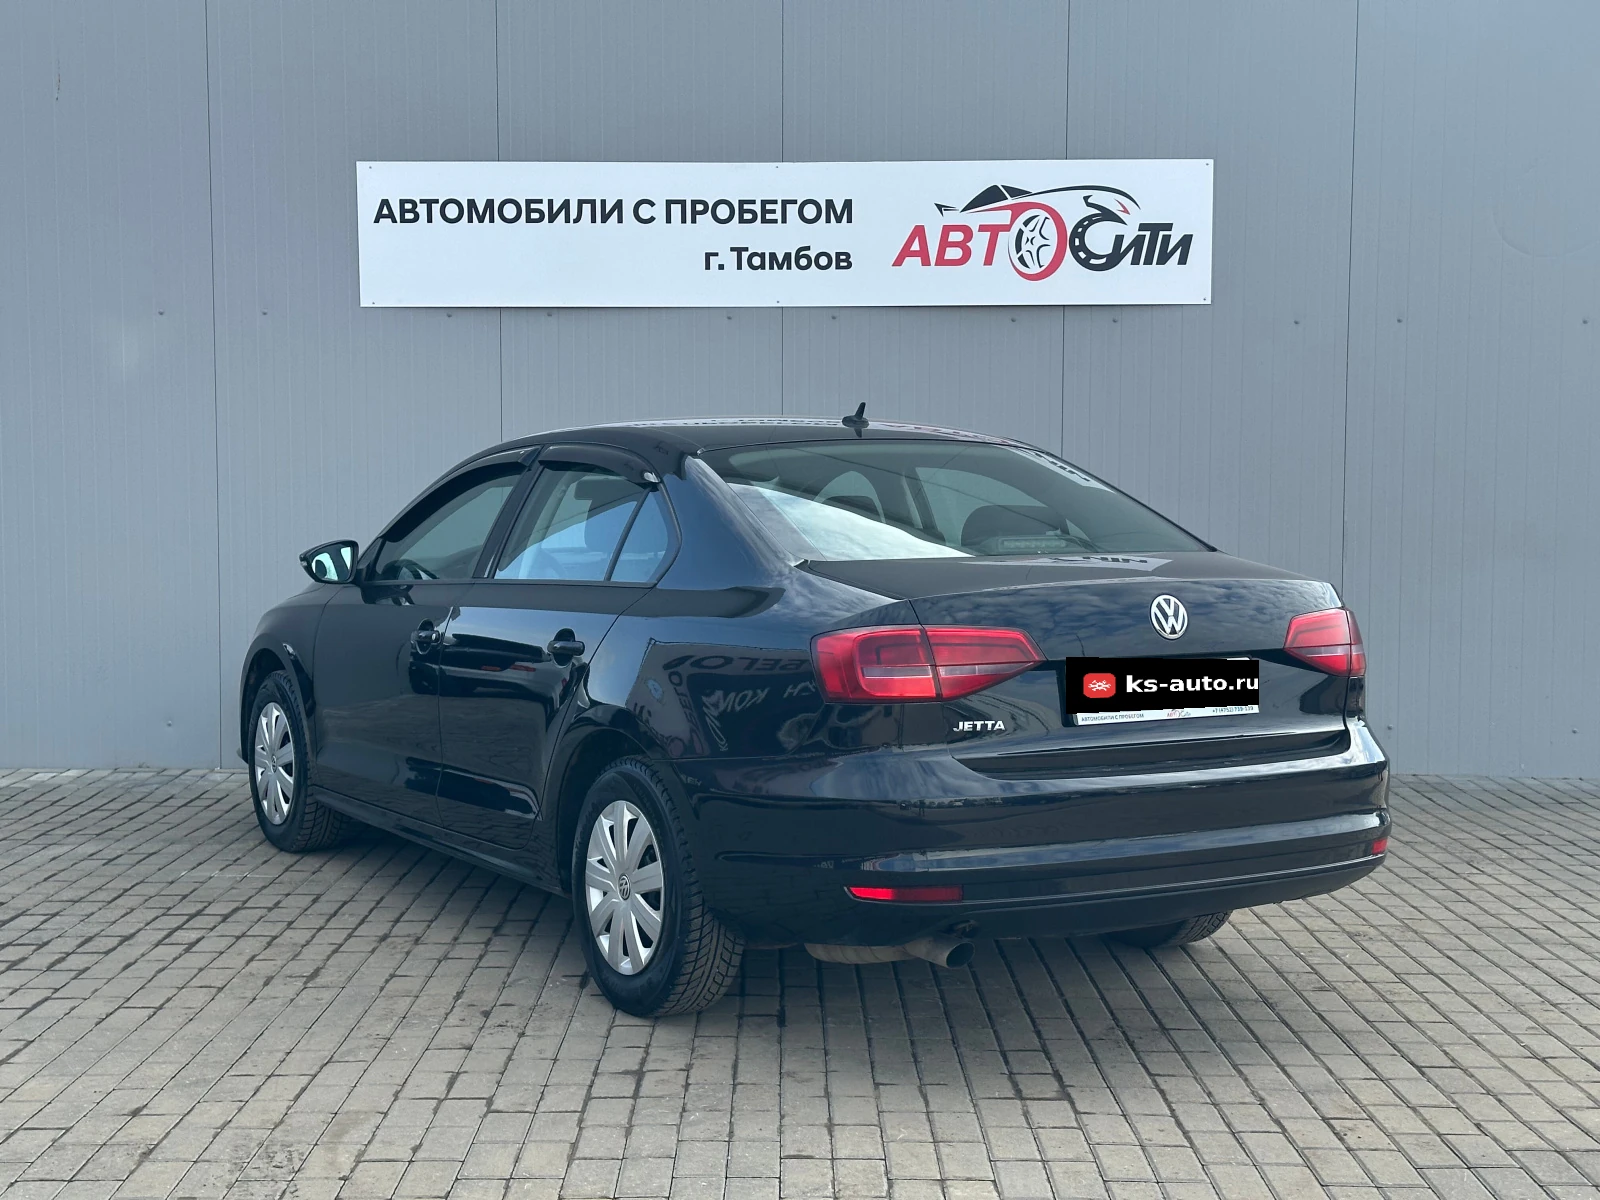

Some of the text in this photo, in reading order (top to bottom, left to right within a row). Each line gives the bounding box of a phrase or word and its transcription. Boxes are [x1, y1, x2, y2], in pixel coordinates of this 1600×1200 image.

[373, 198, 853, 224] АВТОМОБИЛИ С ПРОБЕГОМ
[704, 245, 853, 271] г. Тамбов
[953, 720, 1006, 732] JETTA
